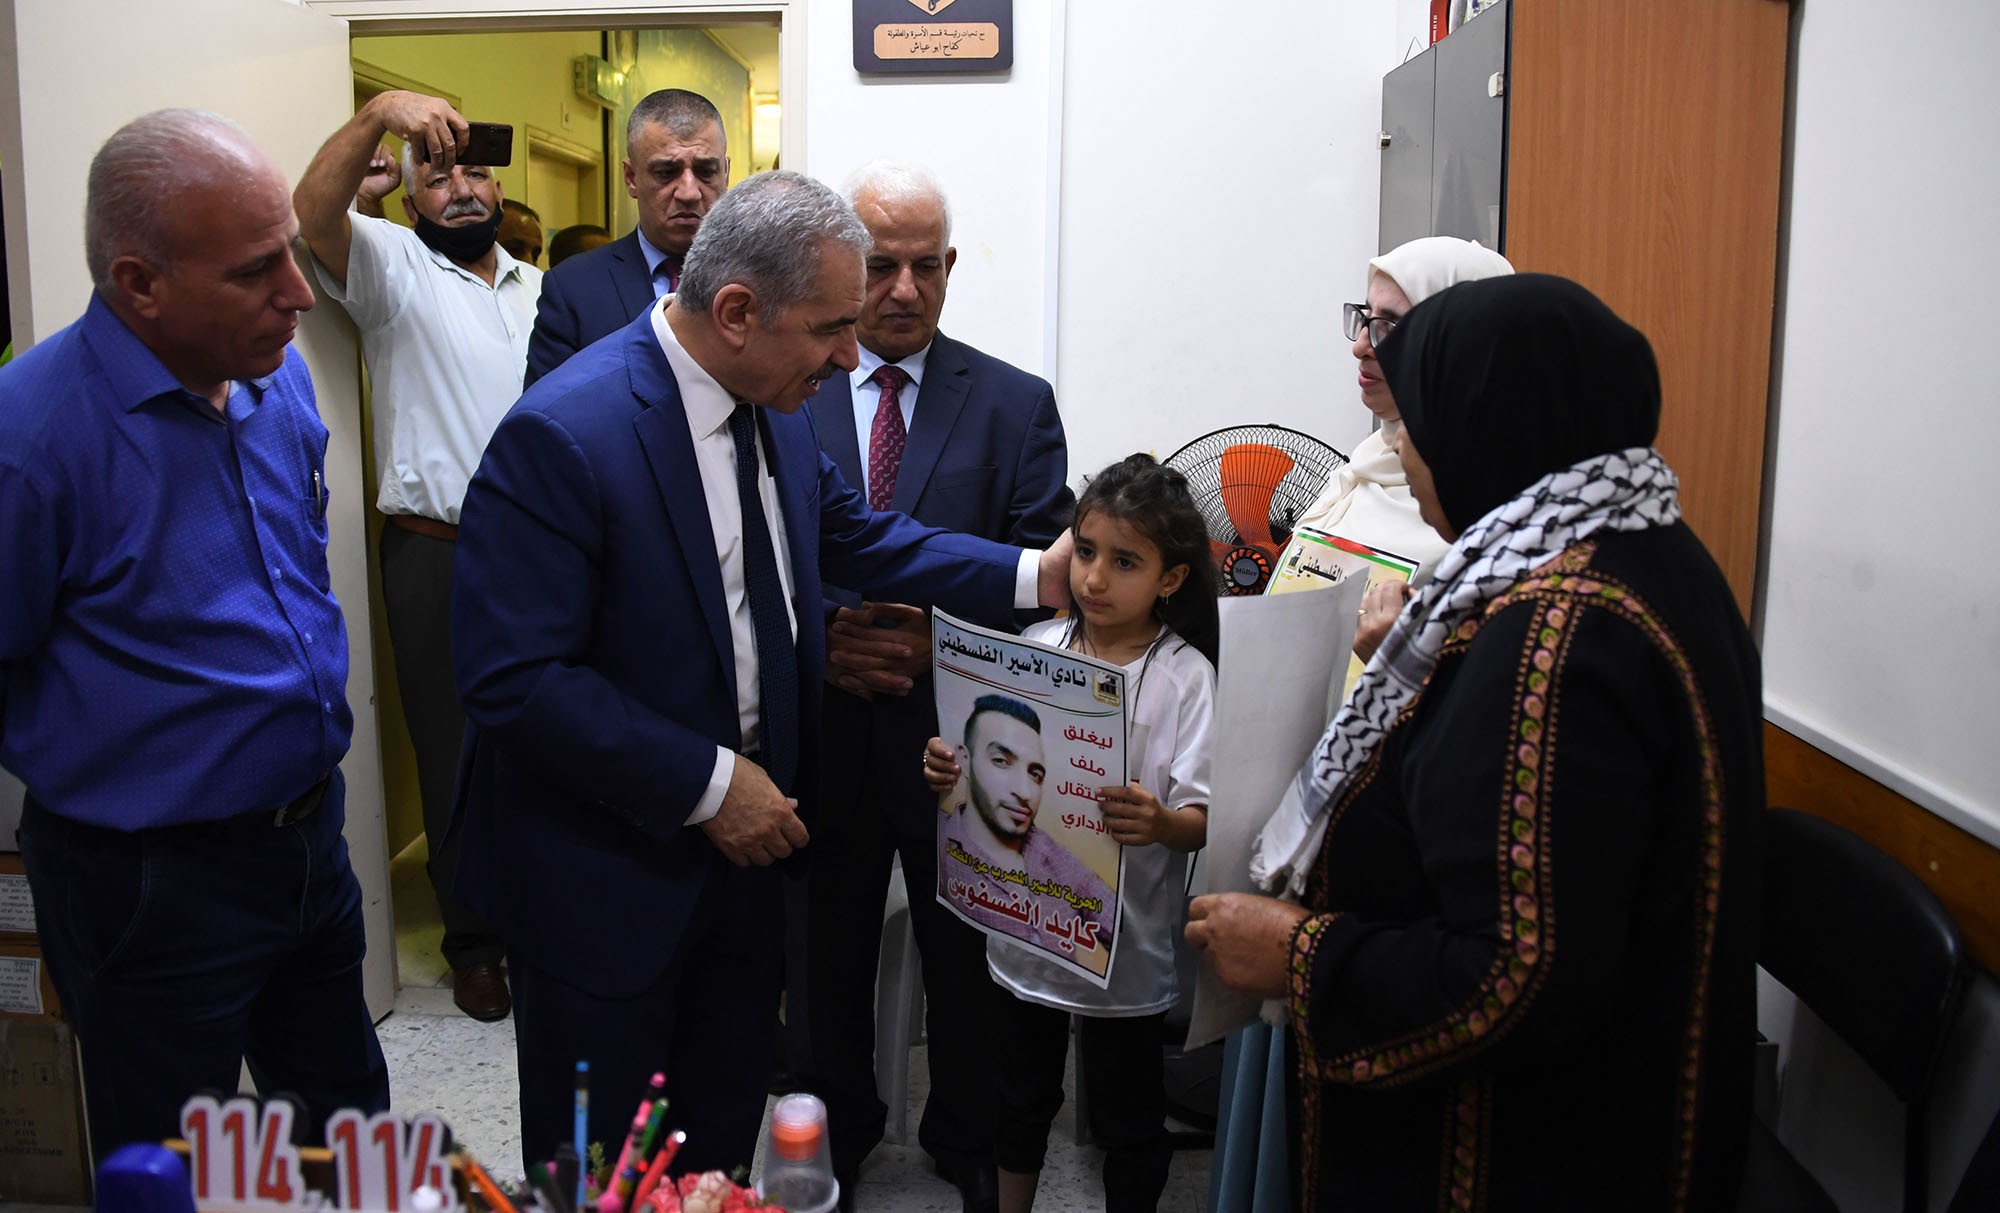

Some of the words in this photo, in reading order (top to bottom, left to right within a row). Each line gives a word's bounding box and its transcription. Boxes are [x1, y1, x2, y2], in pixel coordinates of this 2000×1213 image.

[887, 28, 909, 39] والطفولة
[929, 29, 943, 41] قسم
[910, 42, 930, 53] عياش
[943, 38, 963, 56] كفاح
[939, 632, 1003, 665] الفلسطيني
[1006, 653, 1049, 676] الأسير
[1052, 666, 1086, 688] نادي
[1064, 725, 1113, 749] ليغلق
[1070, 755, 1106, 776] ملف
[972, 857, 990, 874] عن
[991, 865, 1029, 887] المضرب
[947, 877, 1041, 929] الفسفوس
[1064, 885, 1103, 913] الحرية
[1045, 911, 1101, 952] كايد
[185, 1106, 294, 1205] 114
[333, 1116, 450, 1212] 114
